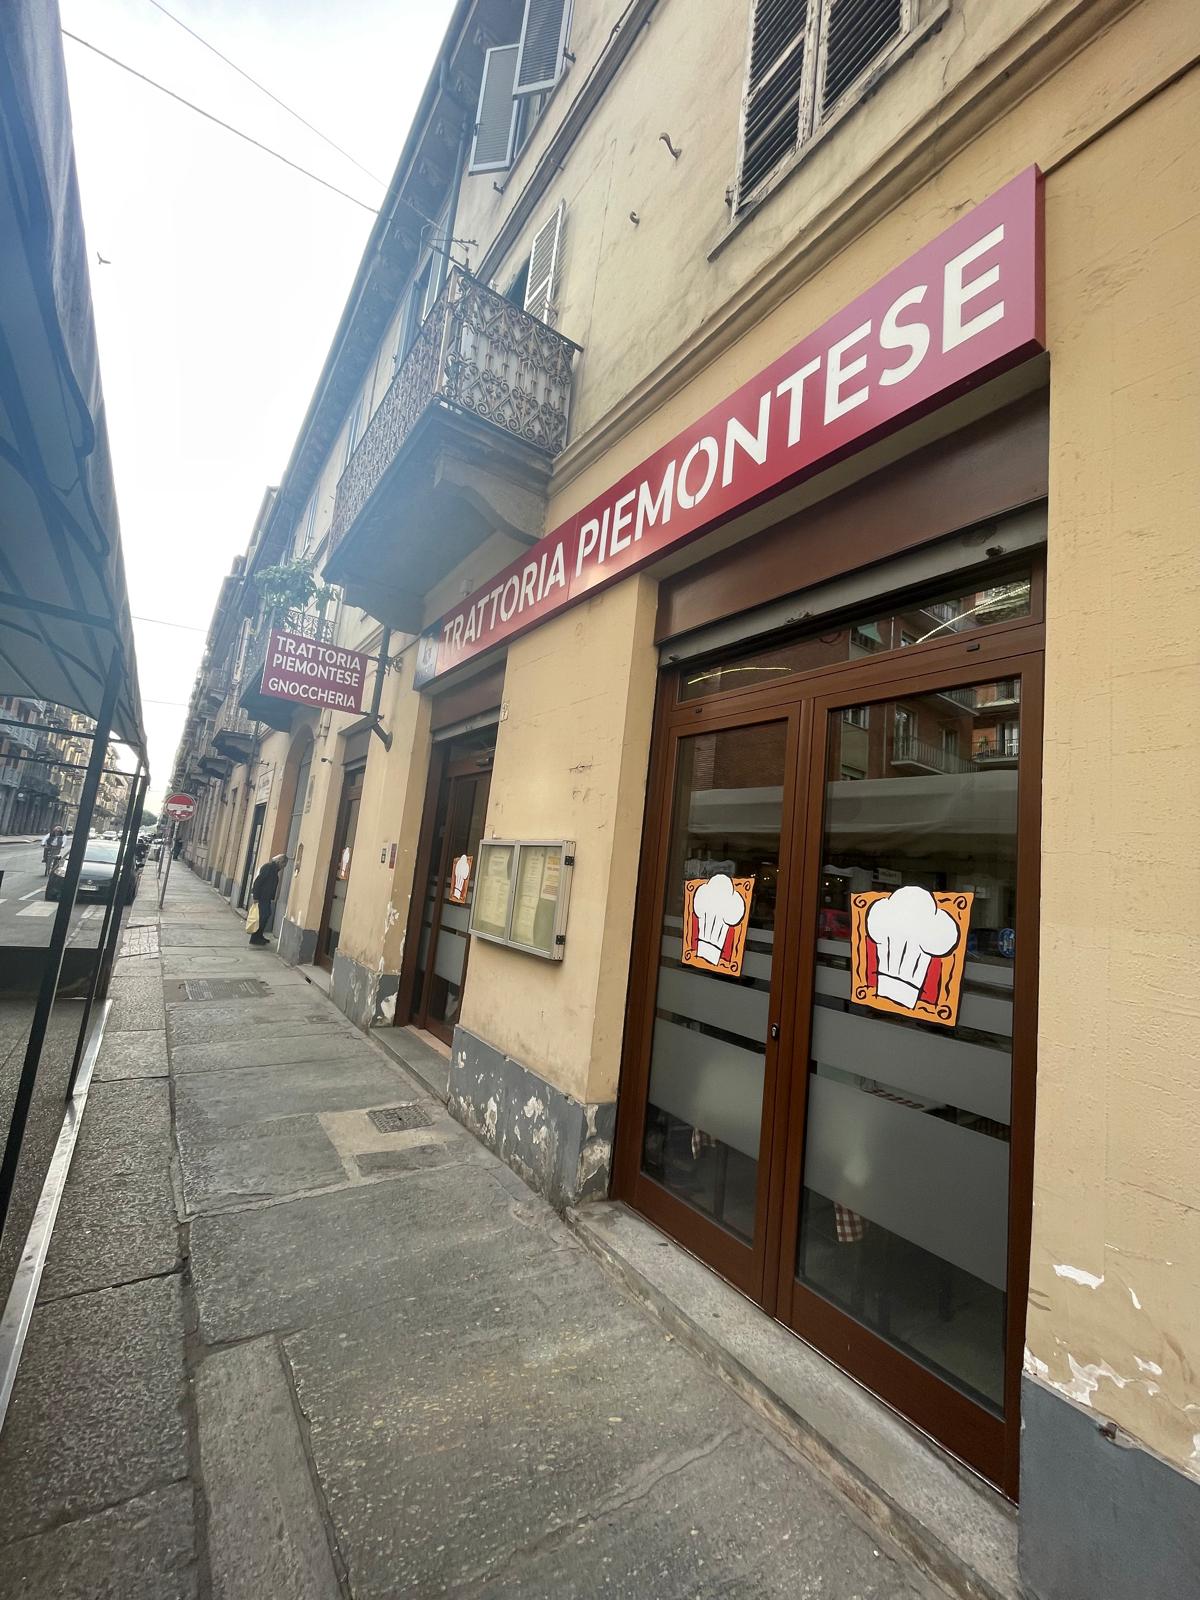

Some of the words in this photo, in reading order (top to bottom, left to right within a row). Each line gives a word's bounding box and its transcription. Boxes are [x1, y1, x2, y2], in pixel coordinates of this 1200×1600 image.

[443, 542, 566, 656] TRATTORIA
[575, 224, 1005, 577] PIEMONTESE
[272, 653, 360, 687] PIEMONTESE
[277, 635, 361, 671] TRATTORIA
[268, 677, 355, 709] GNOCCHERIA
